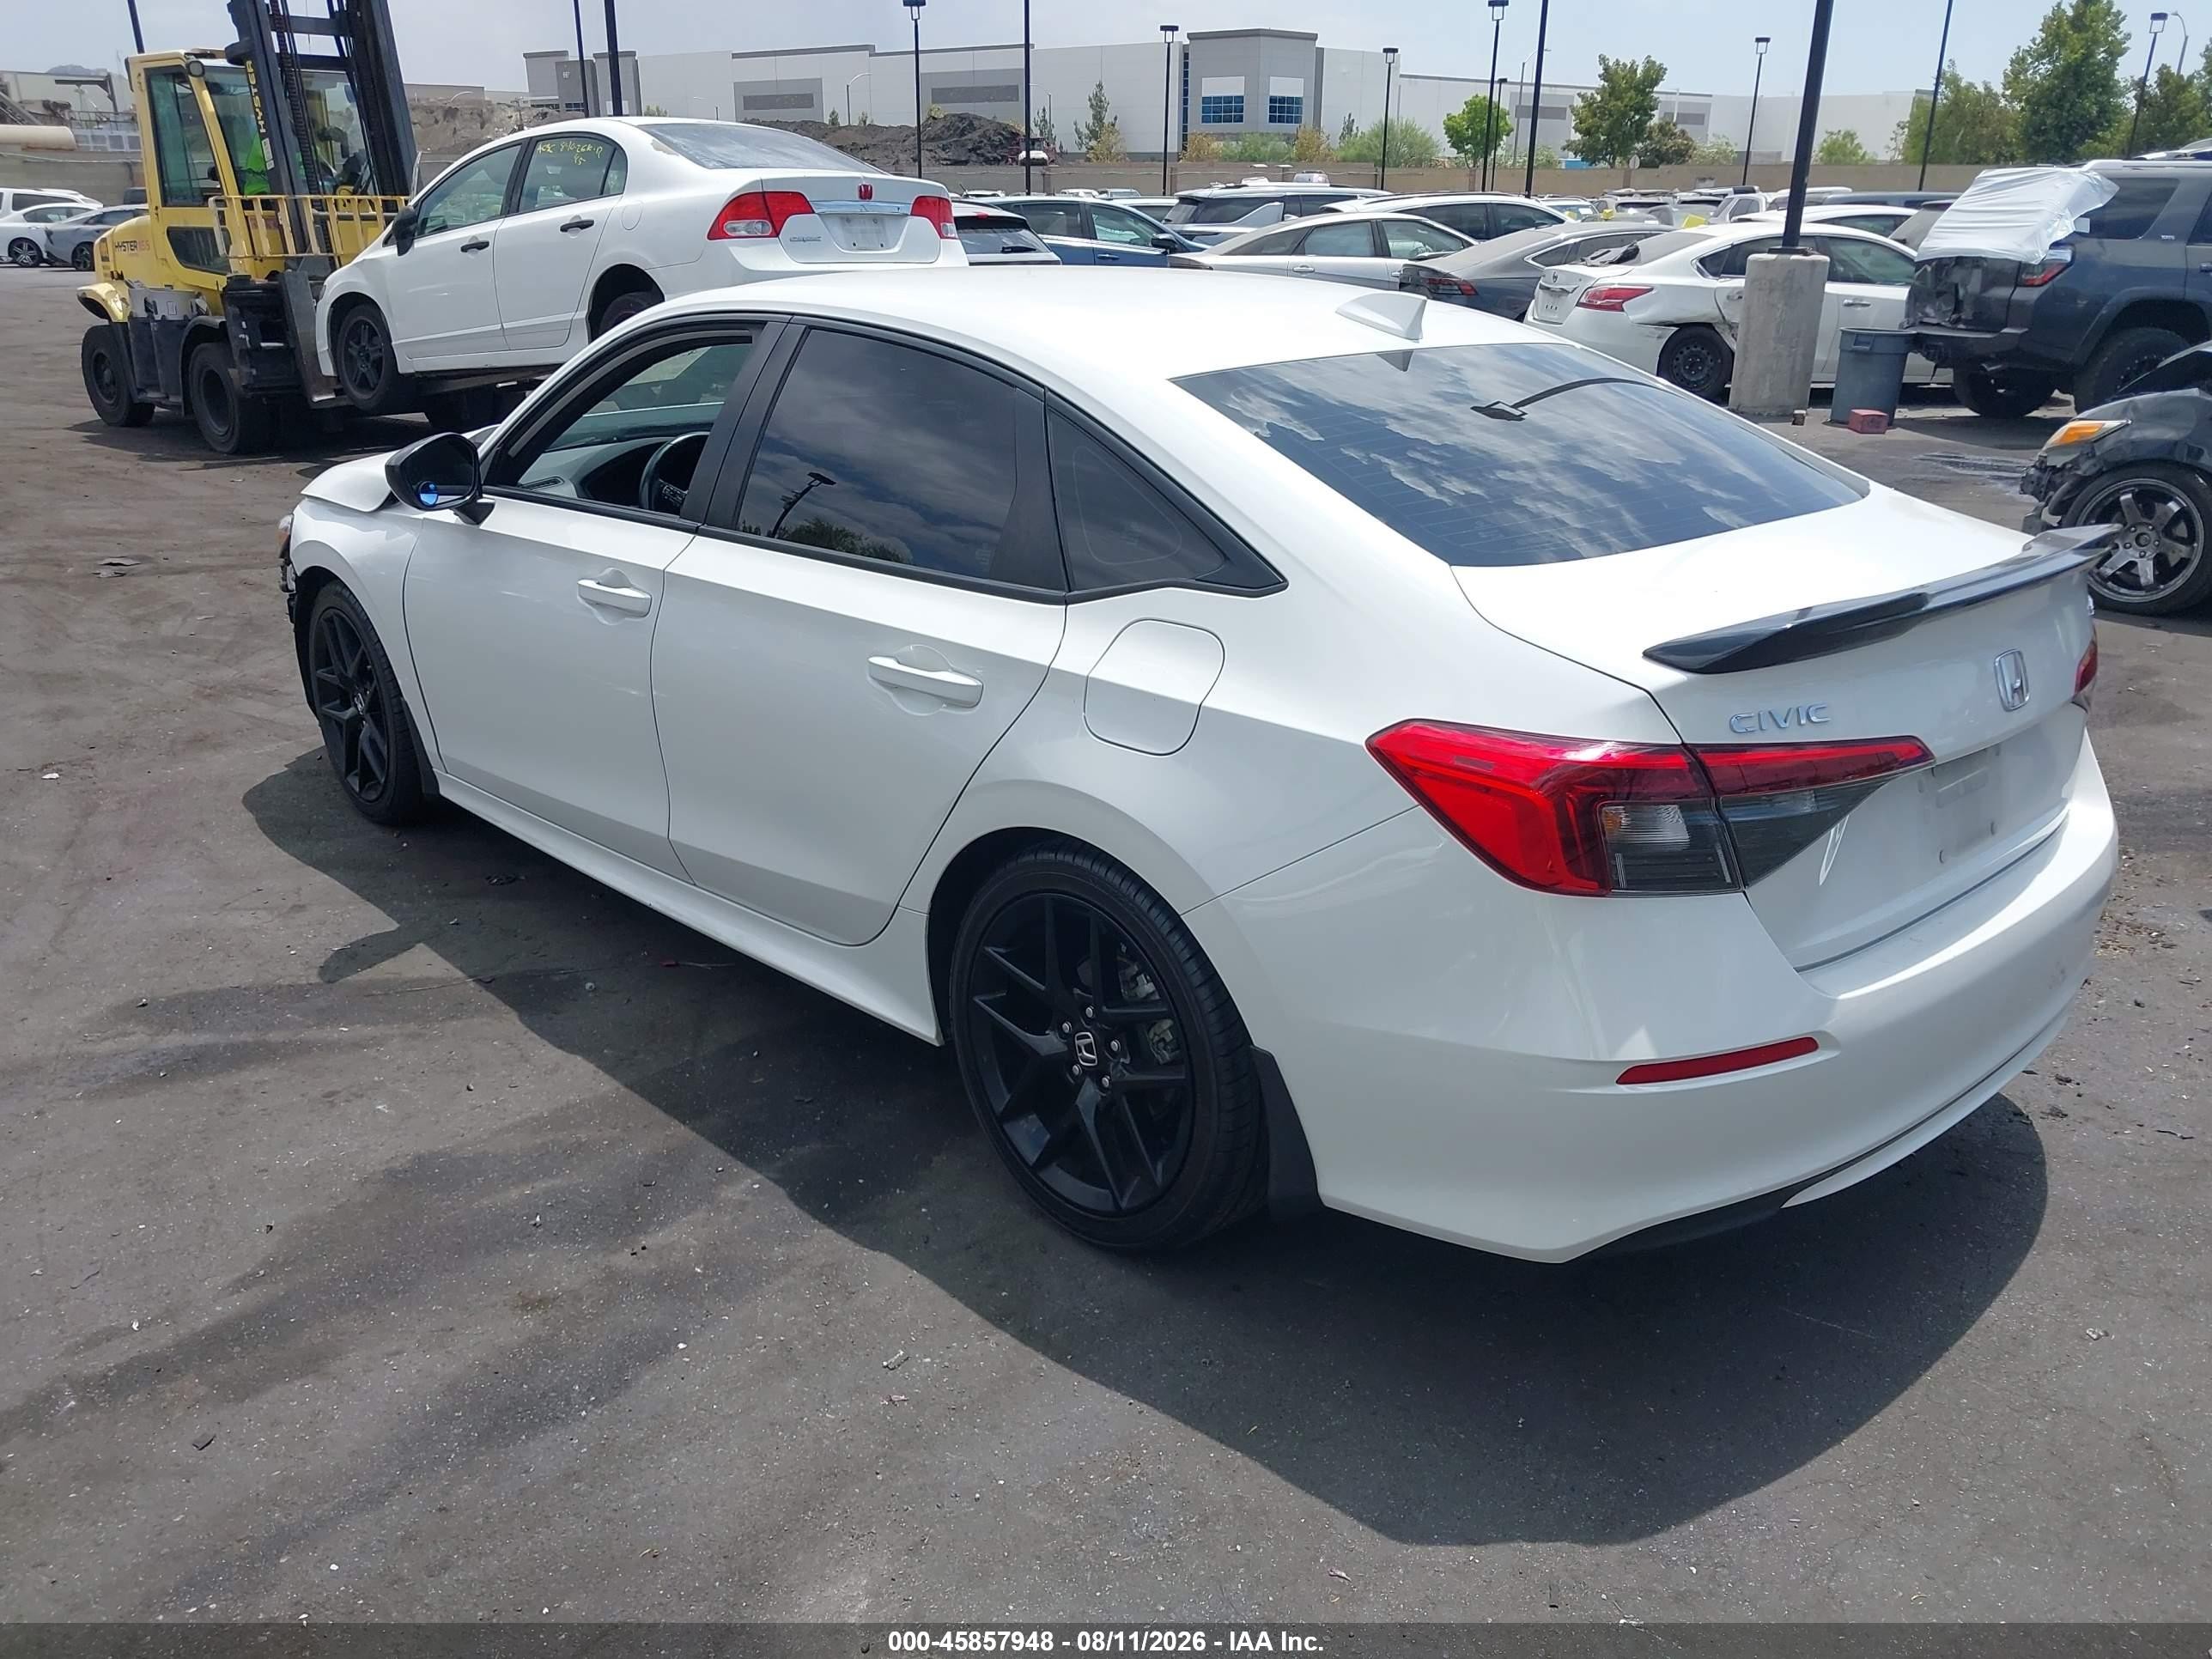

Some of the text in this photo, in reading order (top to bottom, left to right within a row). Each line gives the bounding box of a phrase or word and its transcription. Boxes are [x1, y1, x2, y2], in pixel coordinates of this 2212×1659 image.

[246, 60, 266, 133] HYSTER
[114, 240, 137, 252] HYSTER
[1729, 702, 1832, 734] CIVIC
